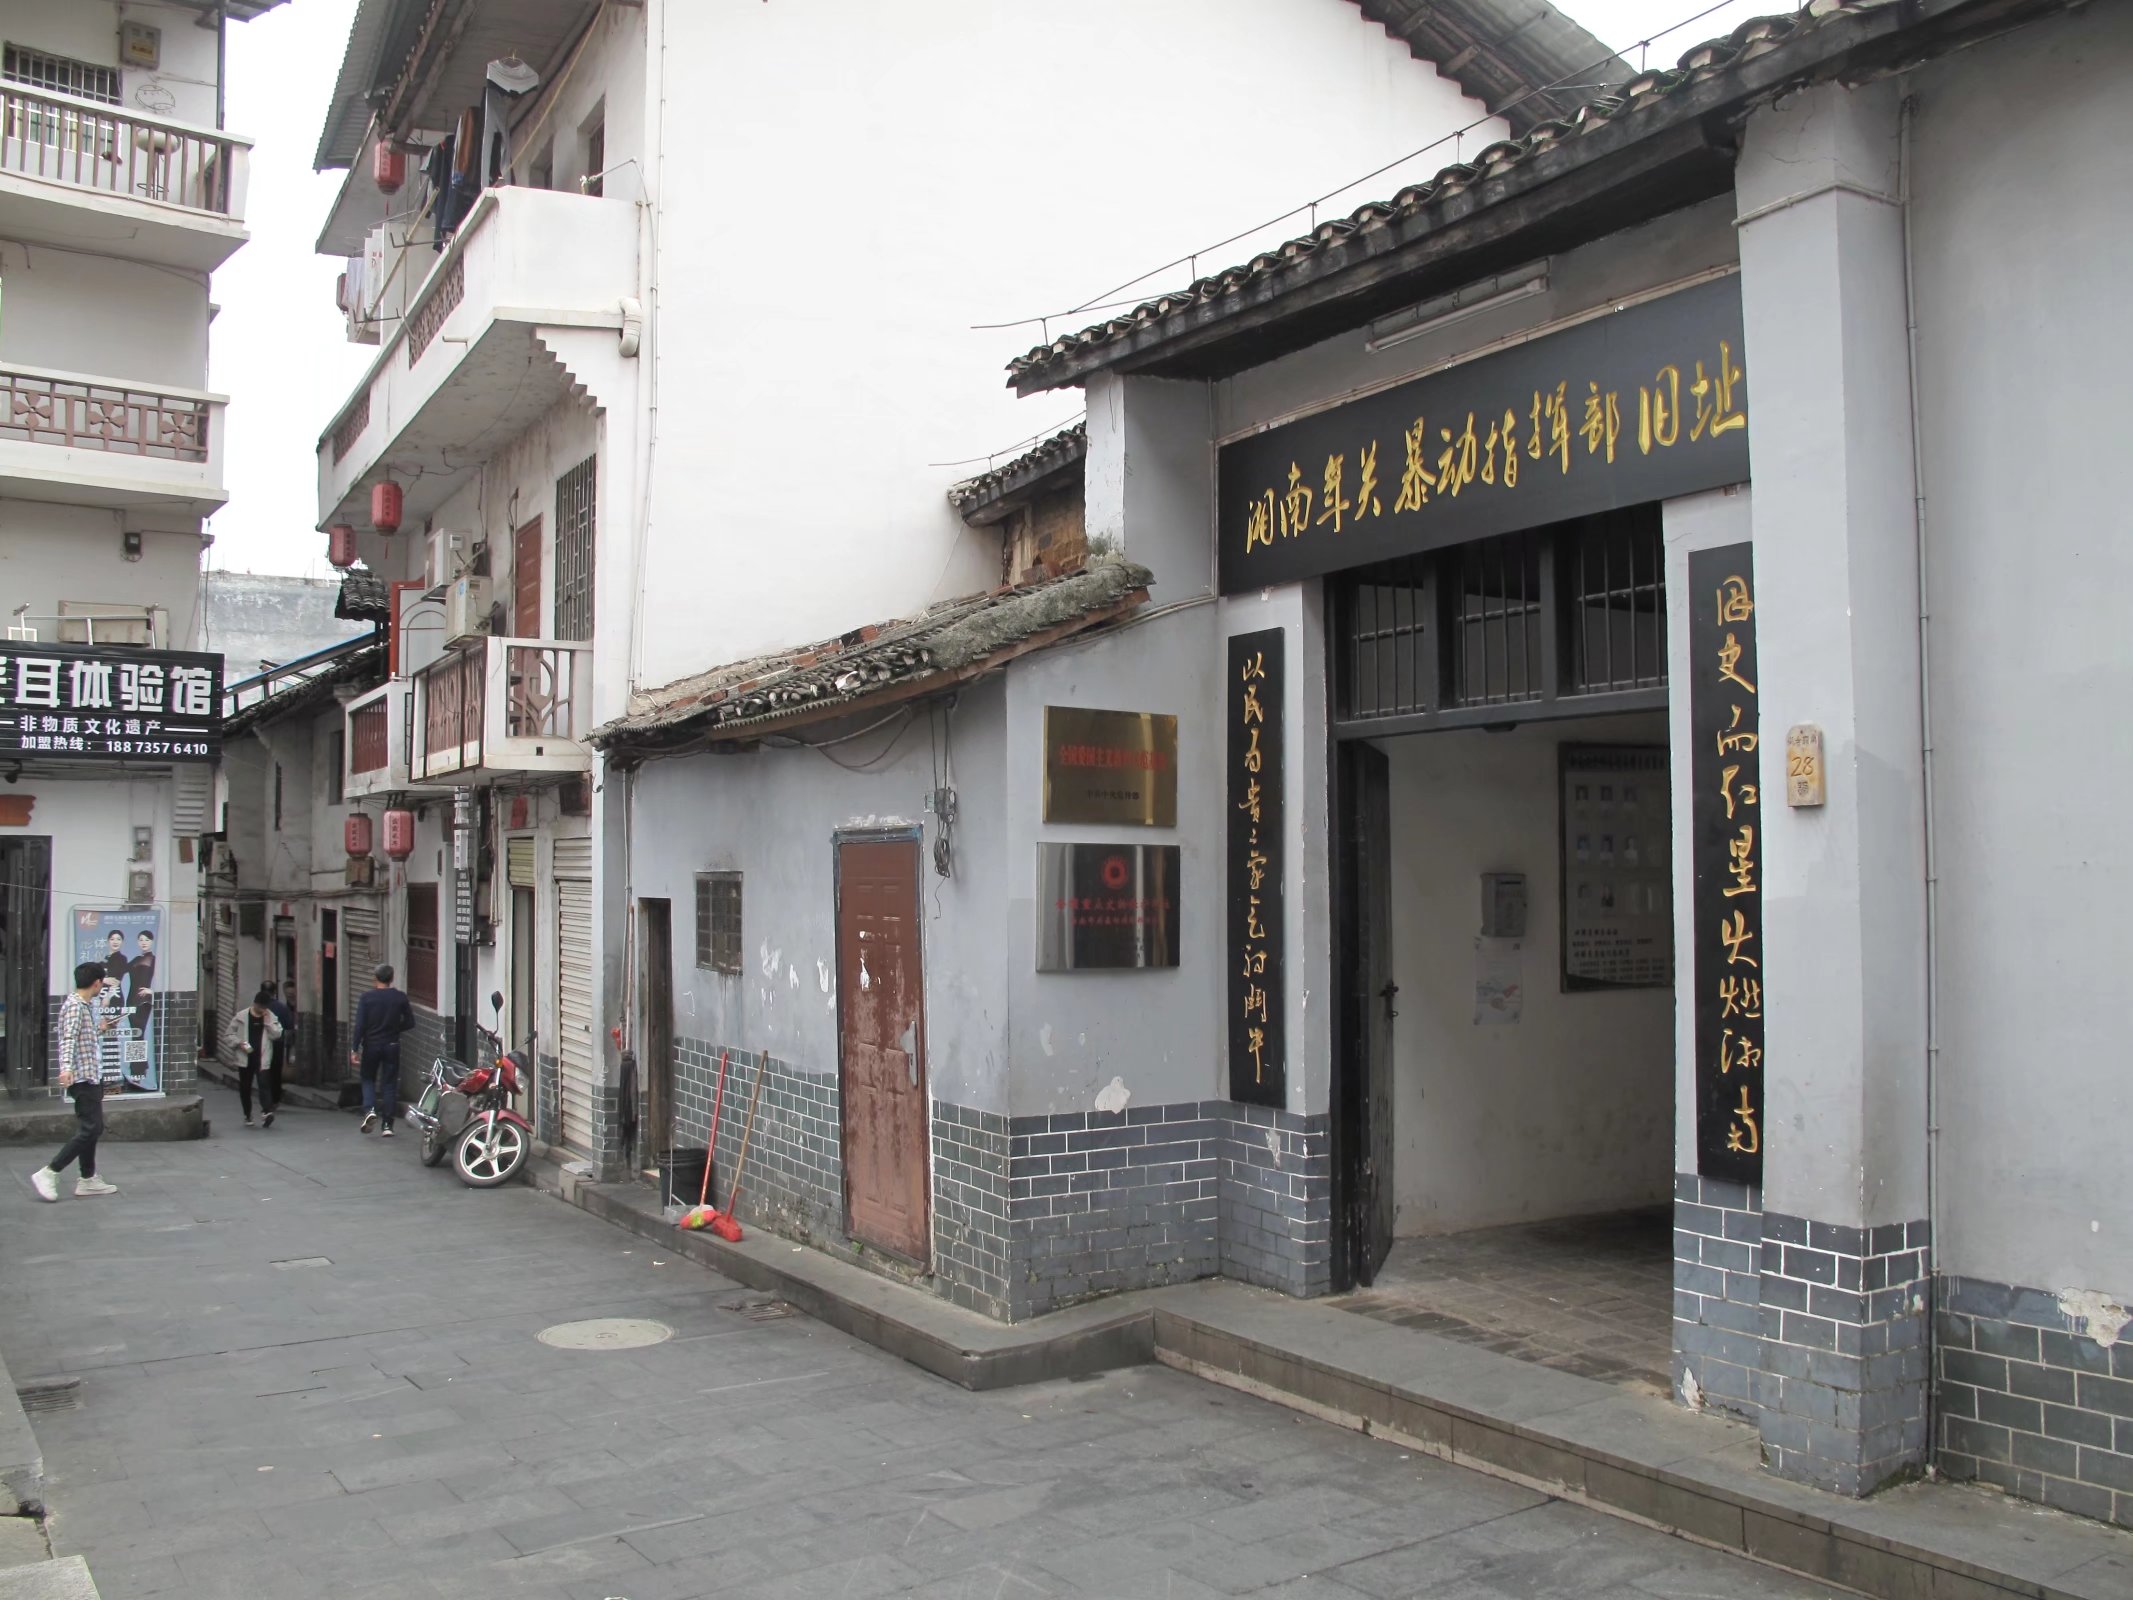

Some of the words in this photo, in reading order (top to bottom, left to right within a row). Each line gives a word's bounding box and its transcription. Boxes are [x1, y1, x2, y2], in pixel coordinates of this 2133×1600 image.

[1246, 339, 1746, 555] 湘南年关暴动指挥部旧址
[0, 655, 213, 716] 耳体验馆
[20, 715, 162, 736] 非物质文化遗产
[106, 740, 132, 753] 188
[135, 741, 170, 754] 7357
[174, 742, 208, 755] 6410
[1790, 756, 1815, 777] 28
